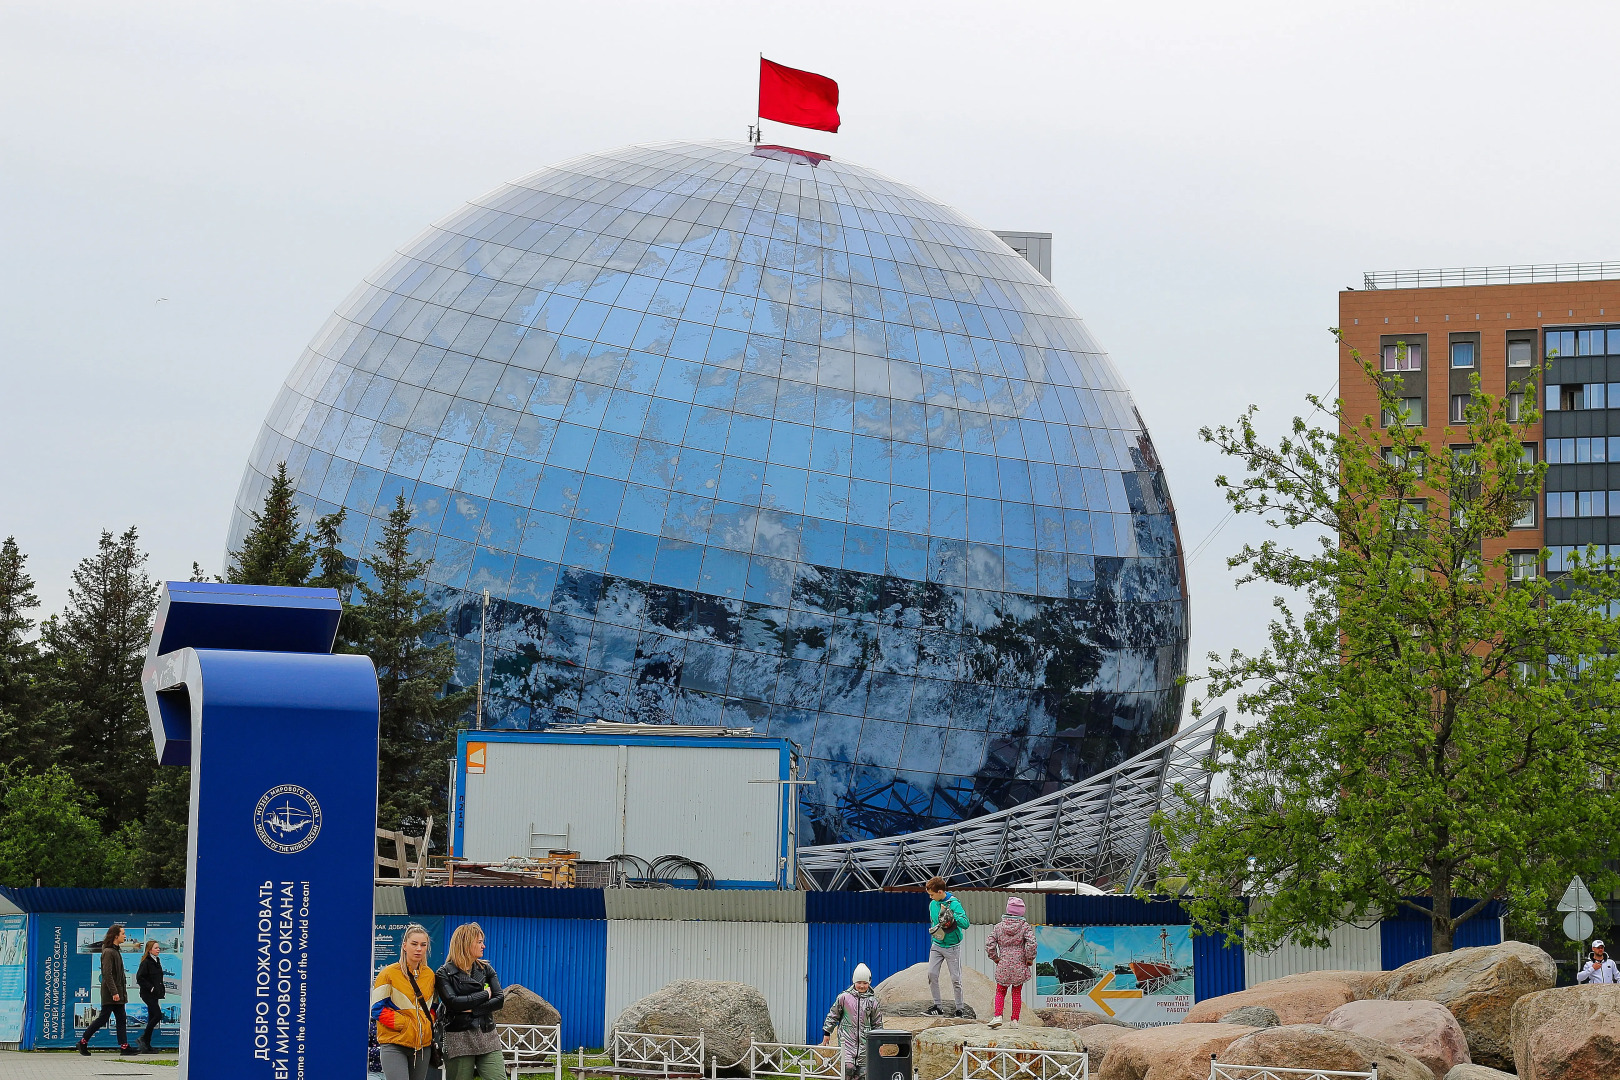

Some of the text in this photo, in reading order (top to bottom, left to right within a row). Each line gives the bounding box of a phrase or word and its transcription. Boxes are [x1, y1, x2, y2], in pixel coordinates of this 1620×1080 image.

[257, 786, 320, 818] МУЗЕЙ МИРОВОГО ОКЕАНА
[290, 840, 308, 851] WORLD
[300, 881, 310, 917] Ocean!
[279, 881, 294, 954] ОКЕАНА!
[299, 920, 309, 950] World
[254, 880, 273, 1060] ДОБРО ПОЖАЛОВАТЬ
[298, 952, 307, 967] the
[298, 969, 307, 980] of
[276, 958, 292, 1054] МИРОВОГО
[296, 982, 307, 1023] Museum
[296, 1026, 305, 1041] the
[297, 1044, 305, 1054] to
